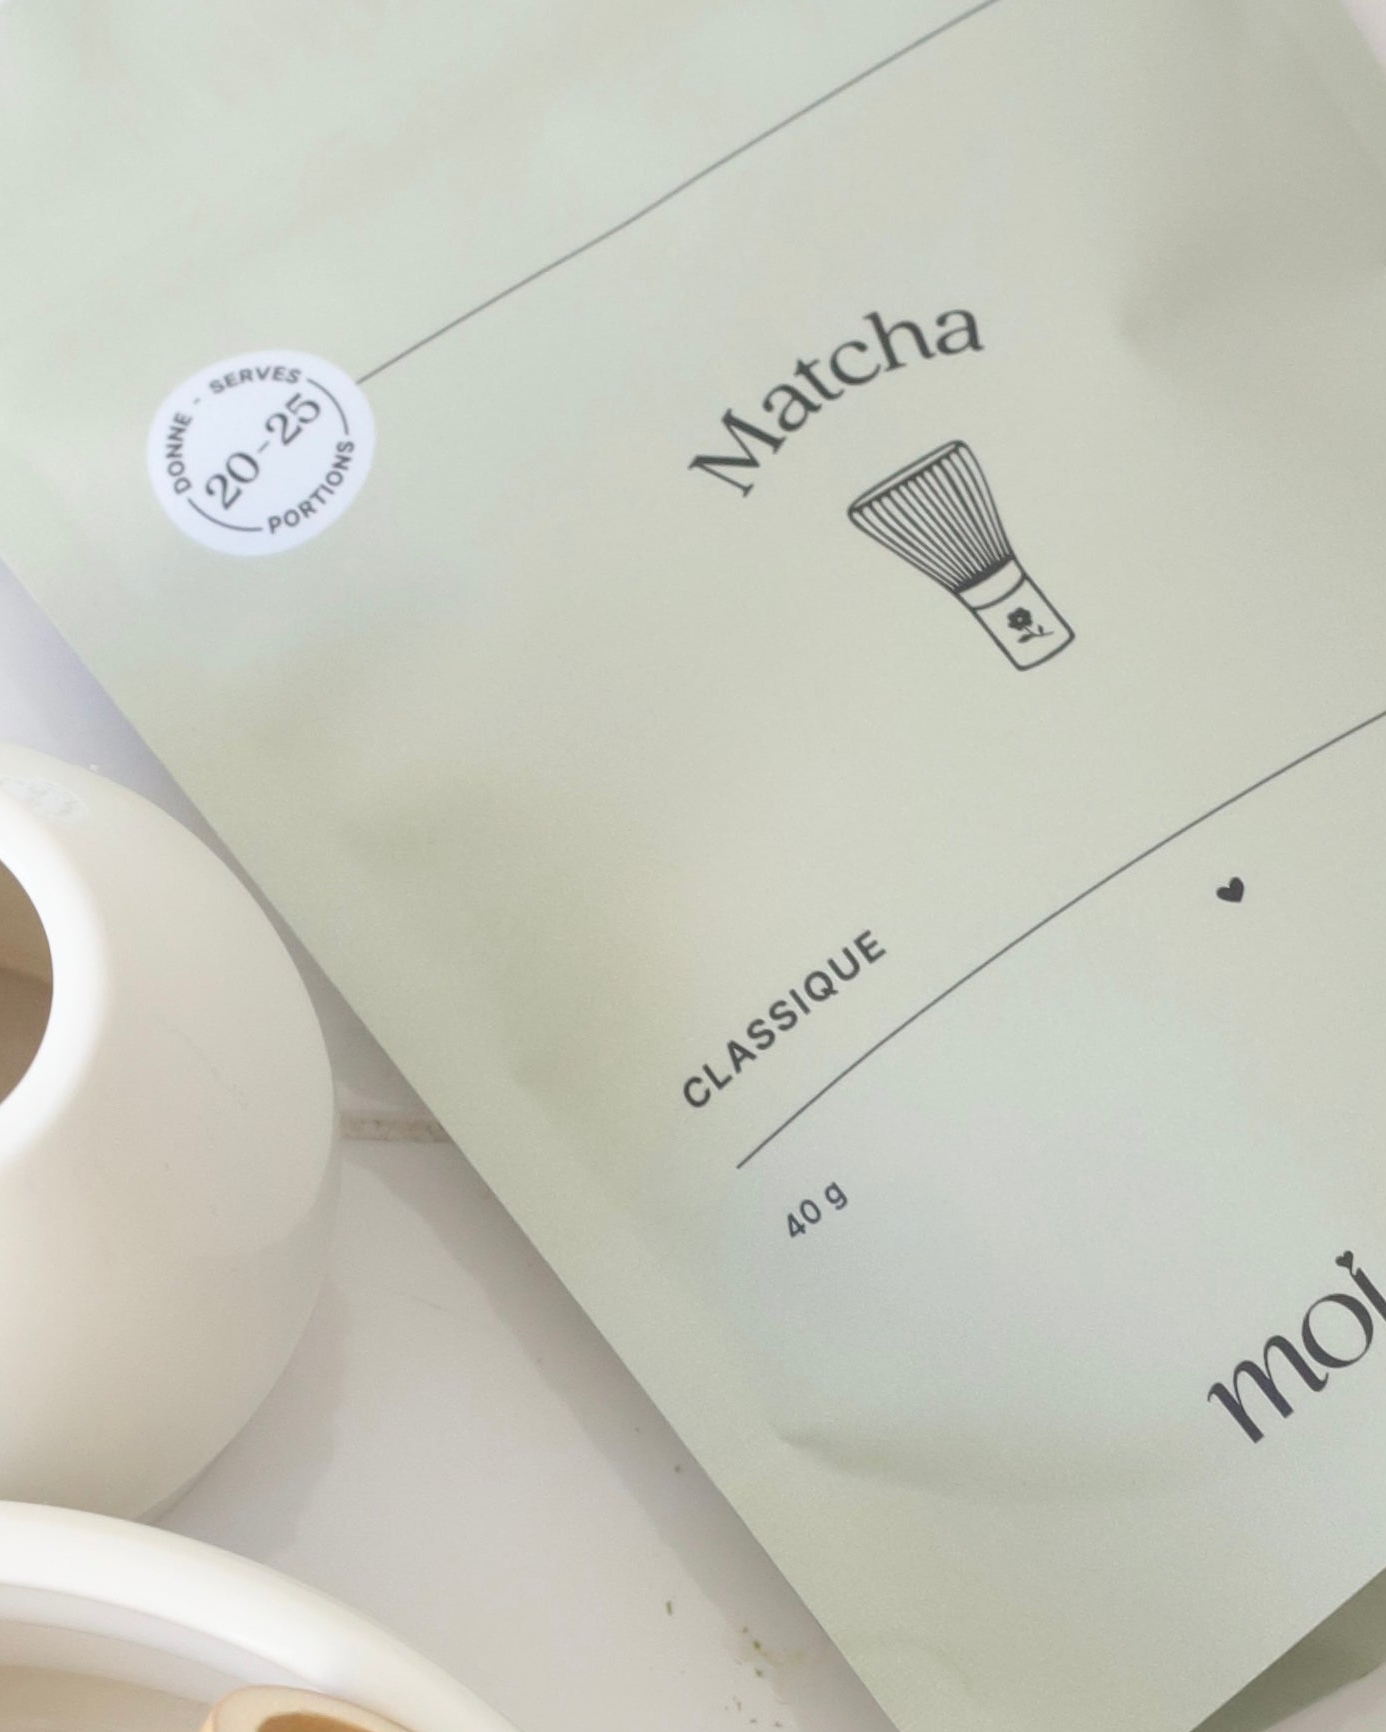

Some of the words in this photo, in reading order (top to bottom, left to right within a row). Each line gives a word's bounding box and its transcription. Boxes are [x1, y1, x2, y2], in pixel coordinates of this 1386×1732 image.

[165, 411, 193, 496] DONNE
[208, 365, 302, 395] SERVES
[688, 309, 985, 498] Matcha
[267, 440, 355, 535] PORTIONS
[682, 928, 888, 1109] CLASSIQUE
[786, 1198, 823, 1239] 40
[824, 1181, 849, 1211] g
